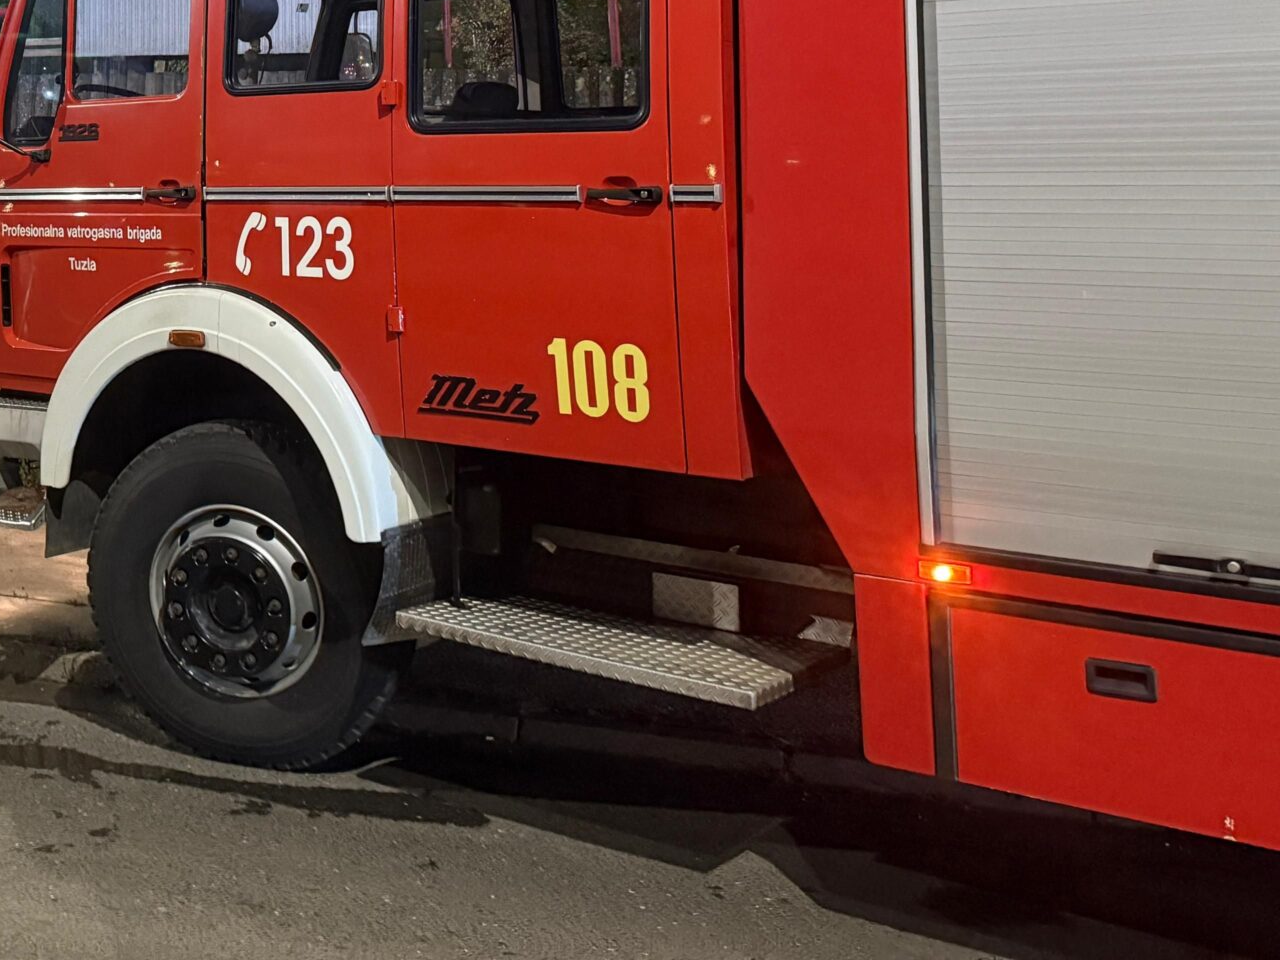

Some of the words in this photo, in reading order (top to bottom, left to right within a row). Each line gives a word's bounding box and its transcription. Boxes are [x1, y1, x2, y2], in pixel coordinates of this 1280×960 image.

[1, 223, 64, 238] Profesionalna
[66, 225, 124, 241] vatrogasna
[127, 226, 162, 243] brigada
[274, 215, 355, 280] 123
[68, 257, 97, 271] Tuzla
[419, 374, 539, 423] Metz
[547, 337, 650, 423] 108
